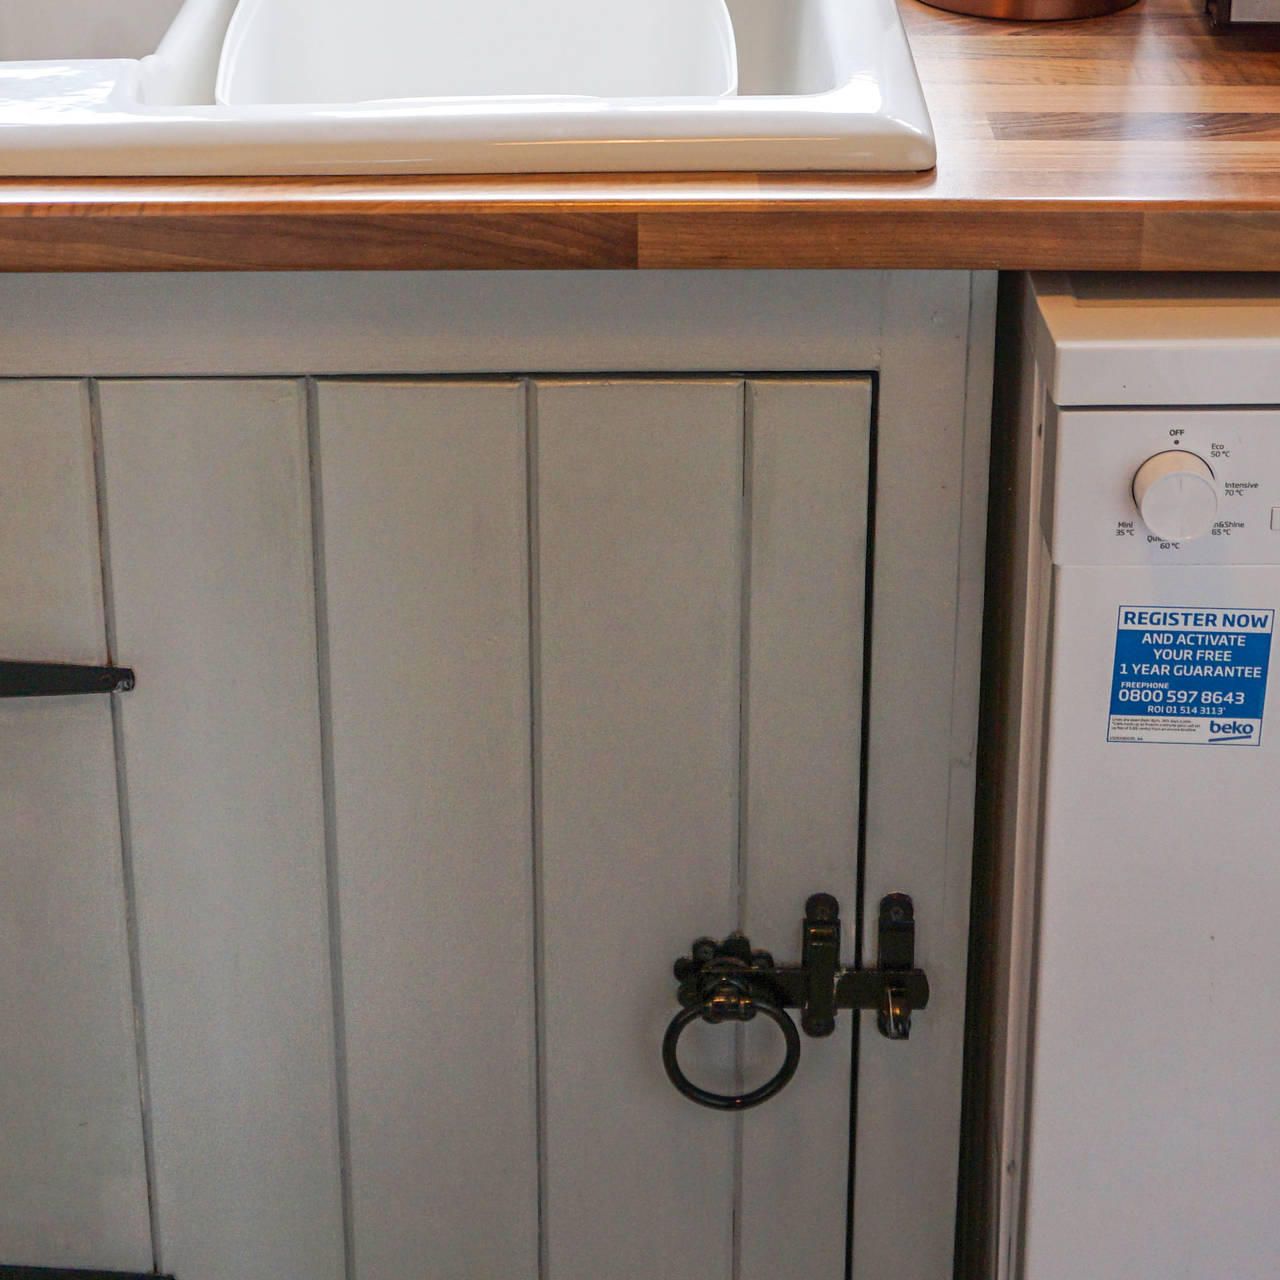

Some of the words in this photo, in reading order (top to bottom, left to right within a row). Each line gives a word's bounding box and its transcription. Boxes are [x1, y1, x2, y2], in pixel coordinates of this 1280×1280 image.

[1123, 611, 1218, 627] REGISTER
[1222, 613, 1269, 628] NOW
[1142, 633, 1173, 645] AND
[1176, 634, 1246, 646] ACTIVATE
[1154, 649, 1193, 661] YOUR
[1196, 650, 1232, 661] FREE
[1120, 663, 1128, 675] 1
[1132, 664, 1170, 676] YEAR
[1173, 665, 1262, 678] GUARANTEE
[1119, 689, 1163, 702] 0800
[1166, 691, 1198, 703] 597
[1201, 691, 1245, 704] 8643
[1166, 706, 1177, 714] 01
[1209, 720, 1254, 734] beko
